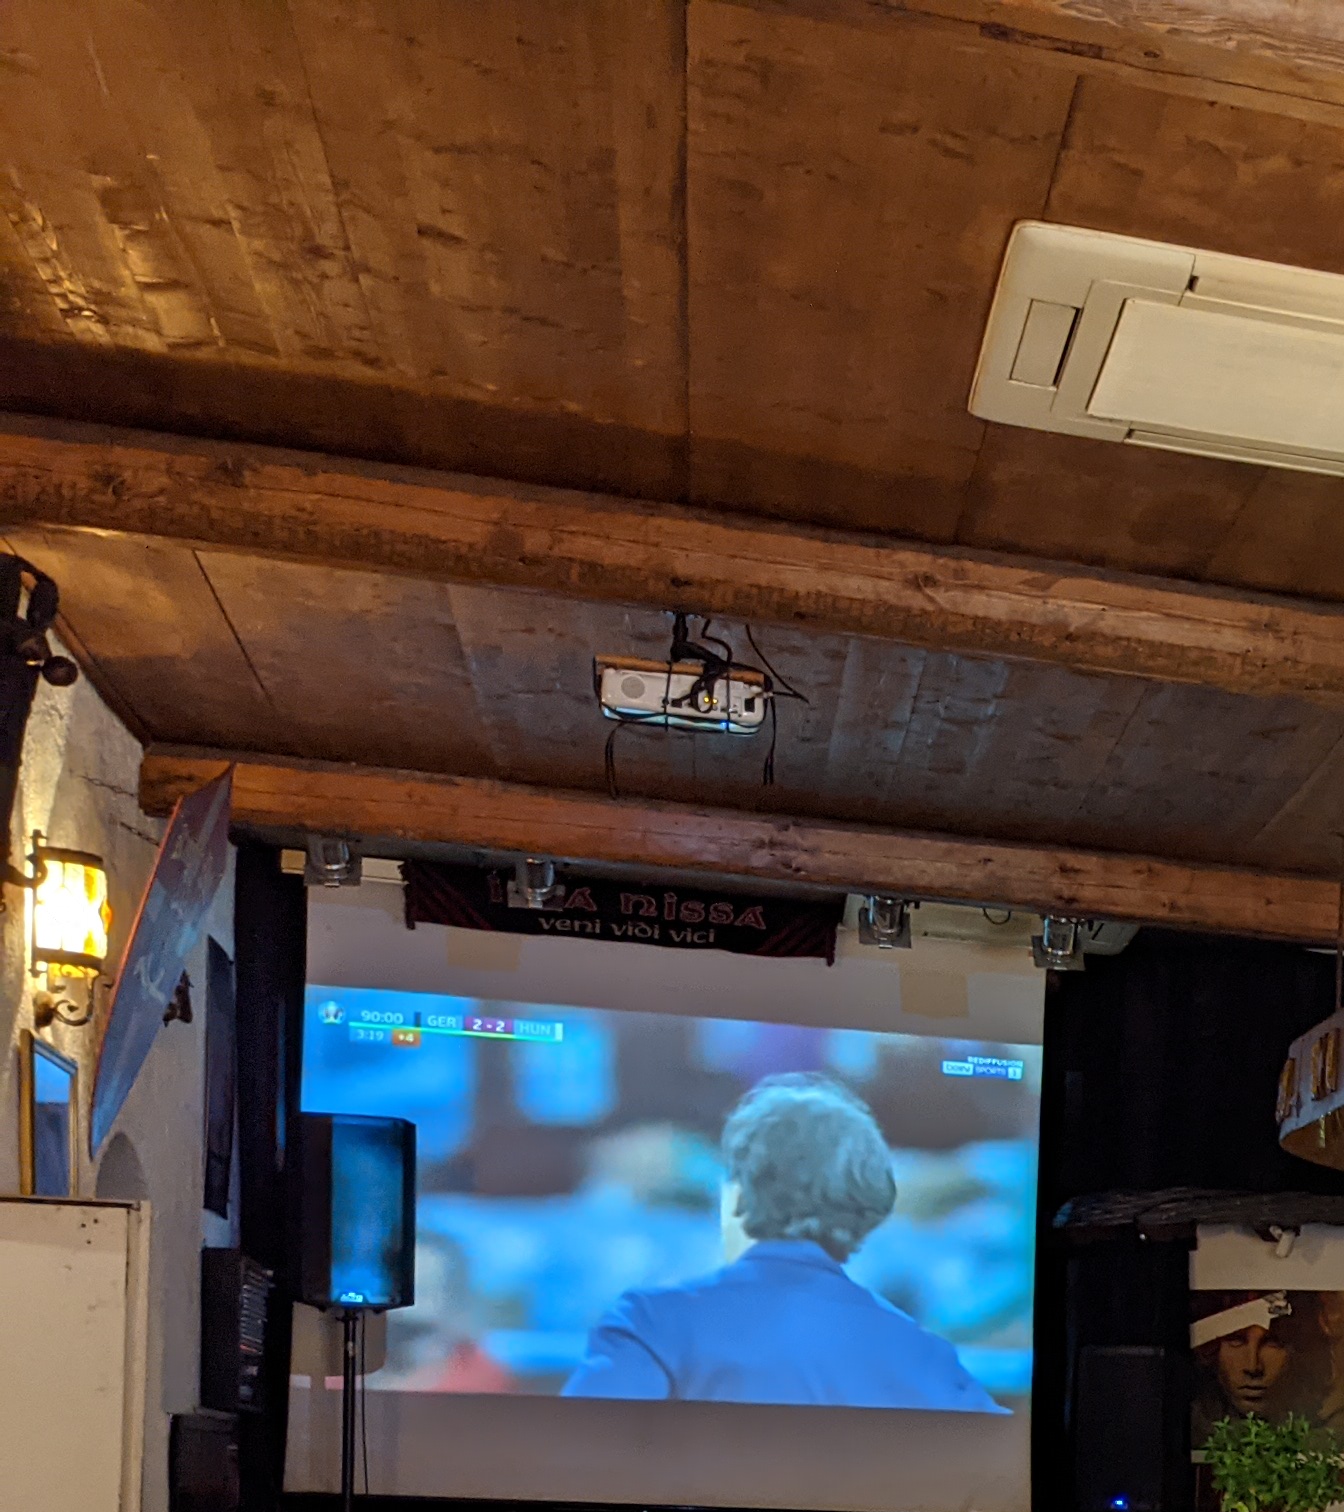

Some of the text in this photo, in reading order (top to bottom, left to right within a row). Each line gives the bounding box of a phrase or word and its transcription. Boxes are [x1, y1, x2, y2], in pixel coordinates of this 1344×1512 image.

[537, 916, 716, 944] veni vidi vici
[356, 1029, 385, 1041] 3:19
[360, 1009, 404, 1025] 90:00
[427, 1014, 457, 1029] GER
[519, 1023, 551, 1036] HUN
